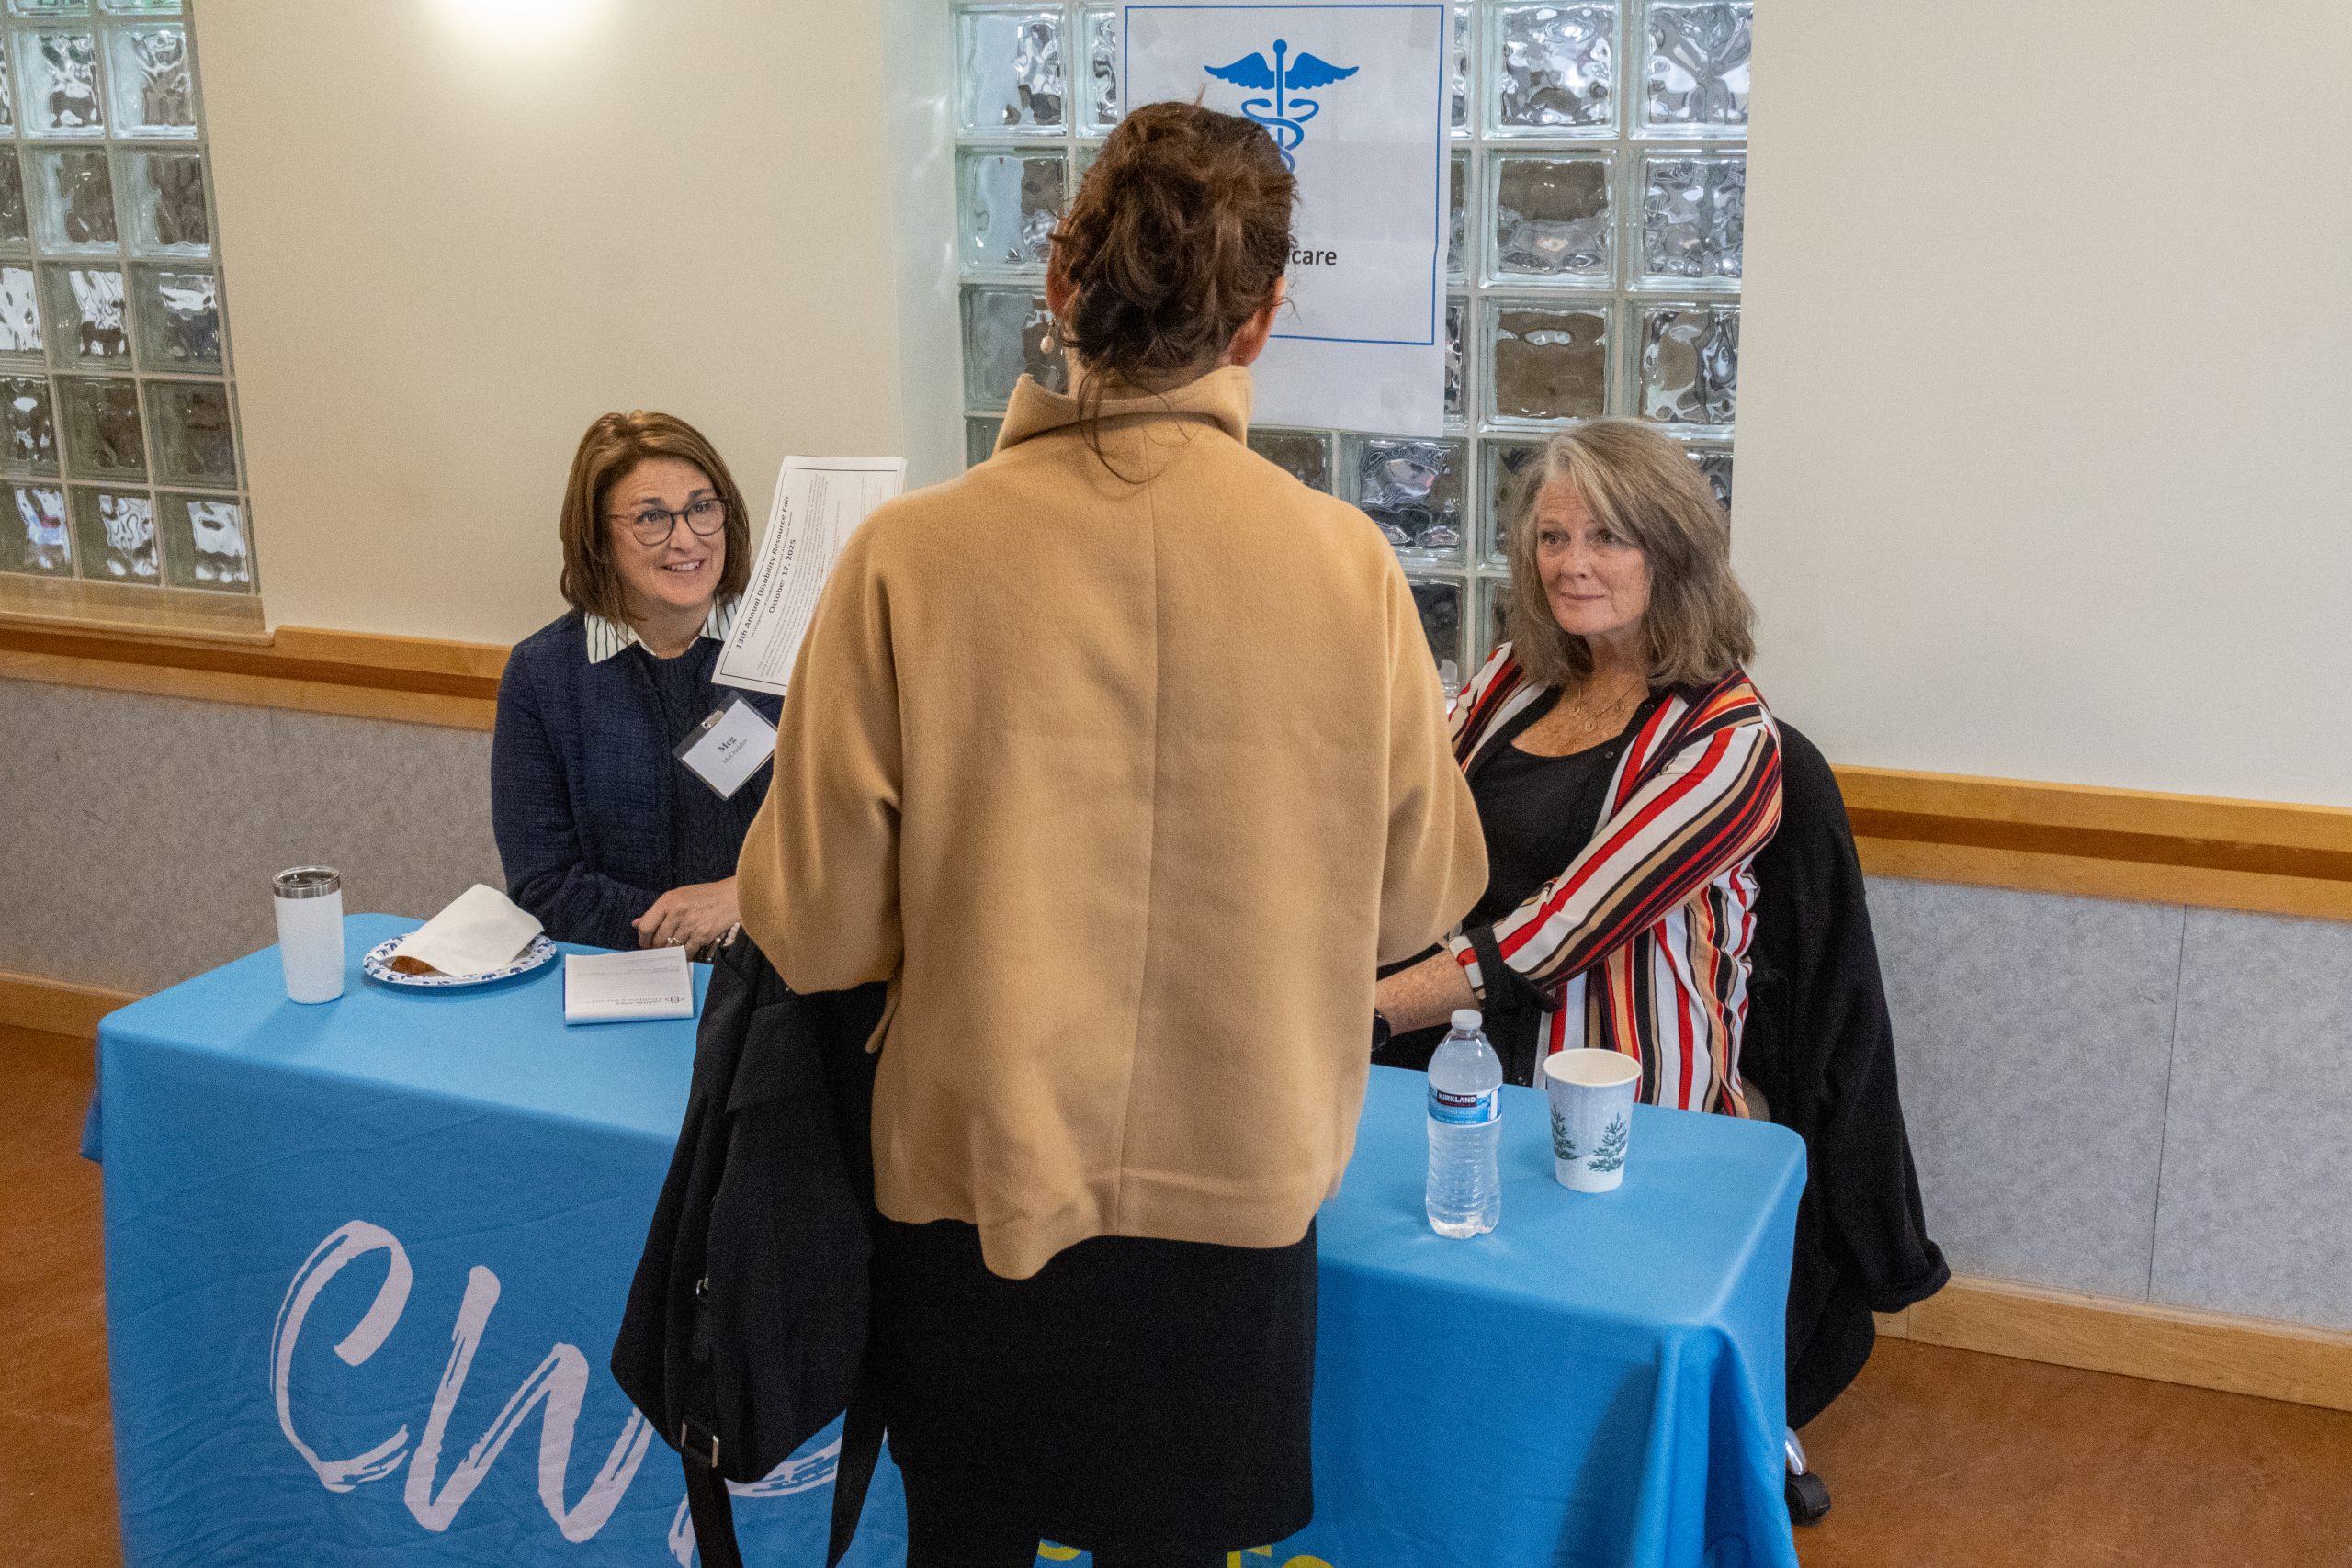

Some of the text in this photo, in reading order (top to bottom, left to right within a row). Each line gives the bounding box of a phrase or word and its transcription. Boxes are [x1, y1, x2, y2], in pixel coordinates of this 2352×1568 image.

[1287, 249, 1337, 265] care
[736, 629, 748, 649] 13th
[744, 597, 761, 628] Annual
[757, 557, 776, 597] Disability
[772, 515, 786, 555] Resource
[768, 538, 796, 614] October 17, 2025
[718, 737, 737, 753] Meg
[1438, 1093, 1476, 1104] KIRKLAND
